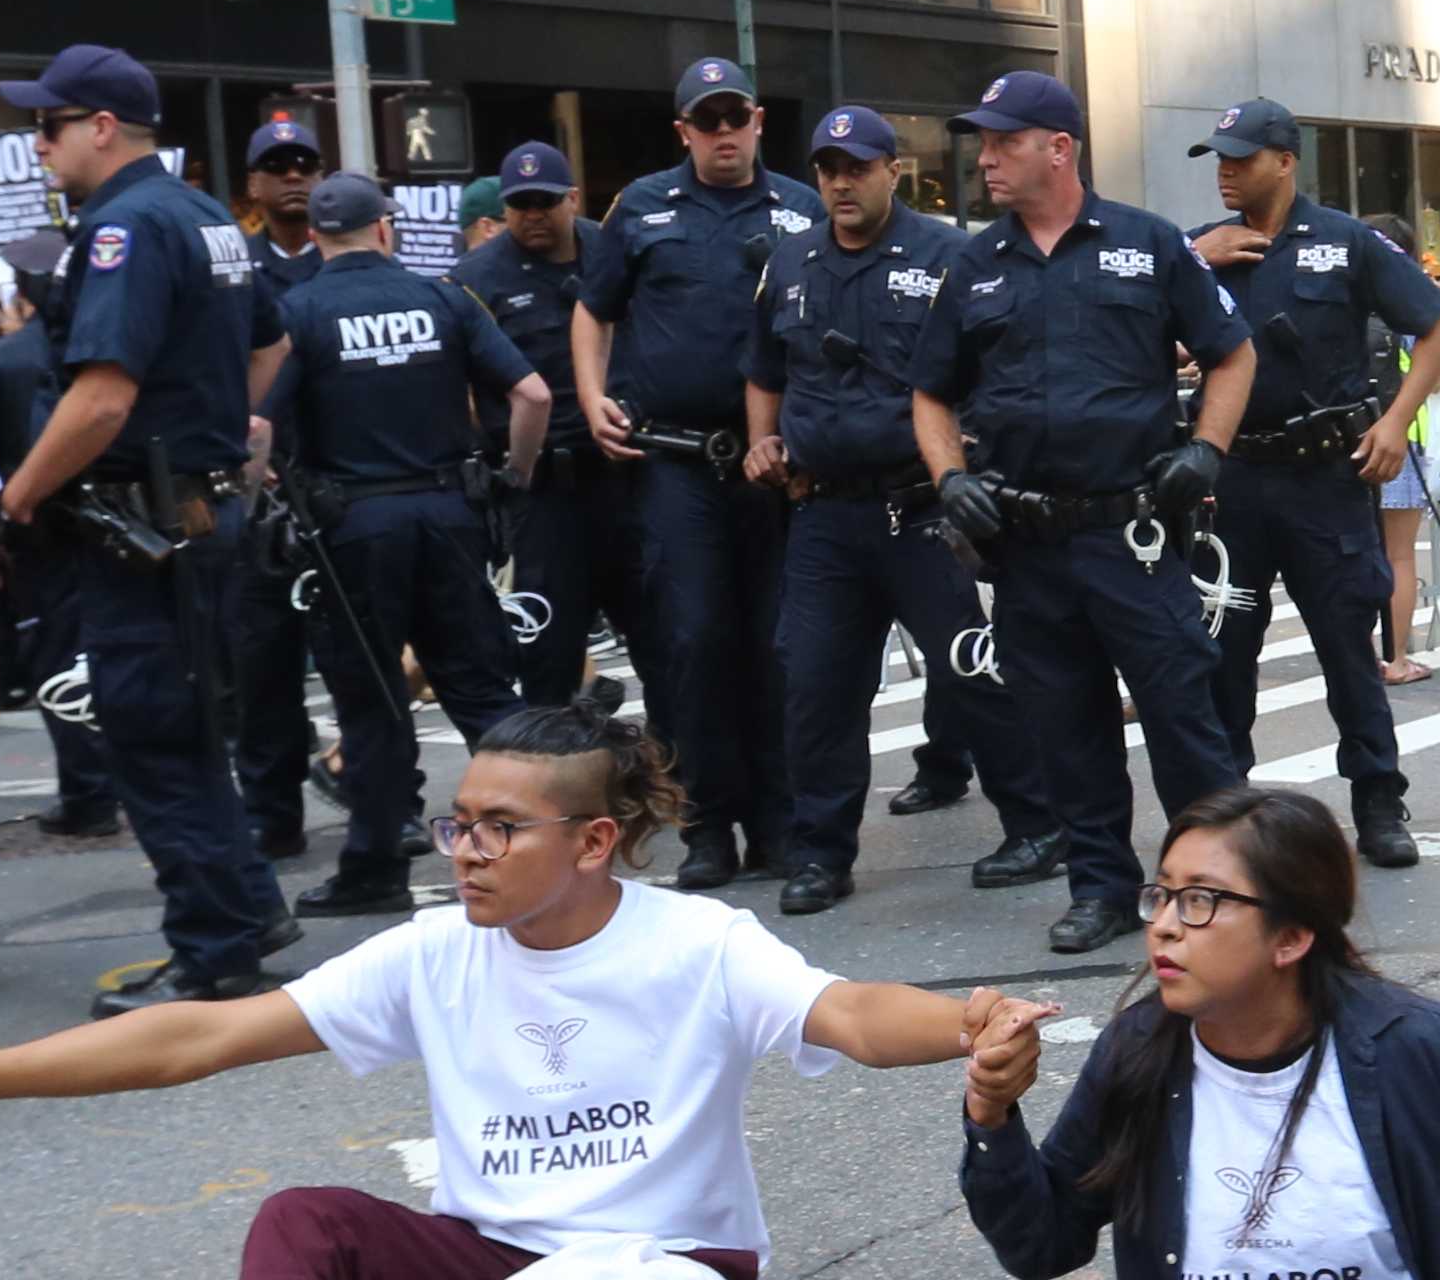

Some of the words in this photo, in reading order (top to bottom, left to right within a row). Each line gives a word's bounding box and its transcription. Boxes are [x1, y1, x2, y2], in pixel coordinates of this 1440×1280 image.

[392, 183, 463, 222] NO!
[1098, 250, 1155, 269] POLICE
[1297, 247, 1349, 262] POLICE
[887, 270, 942, 292] POLICE
[337, 308, 436, 350] NYPD
[526, 1080, 588, 1096] COSECHA
[480, 1114, 540, 1142] #MI
[544, 1099, 654, 1139] LABOR
[481, 1148, 520, 1177] MI
[530, 1135, 649, 1174] FAMILIA
[1224, 1237, 1295, 1251] COSECHA
